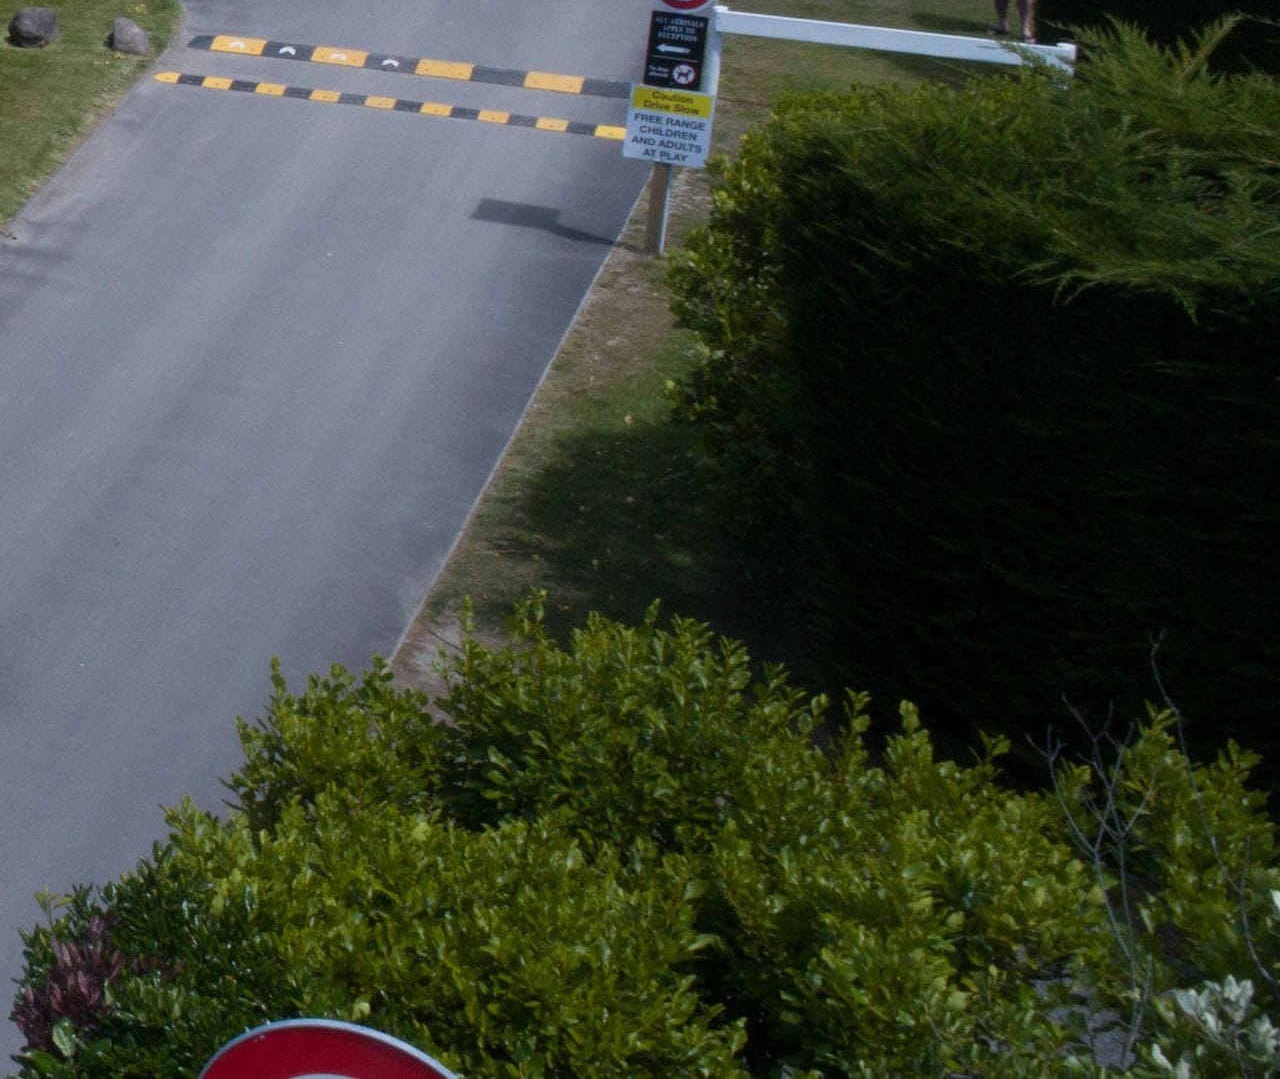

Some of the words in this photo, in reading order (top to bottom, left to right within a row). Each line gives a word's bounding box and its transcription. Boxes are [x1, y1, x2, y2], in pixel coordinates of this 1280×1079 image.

[652, 91, 694, 104] Caution
[643, 99, 671, 111] Drive
[673, 104, 700, 115] Slow
[633, 113, 663, 125] FREE
[666, 118, 706, 131] RANGE
[639, 125, 697, 140] CHILDREN
[631, 136, 656, 146] AND
[658, 140, 702, 153] ADULTS
[643, 149, 657, 157] AT
[659, 151, 688, 161] PLAY
